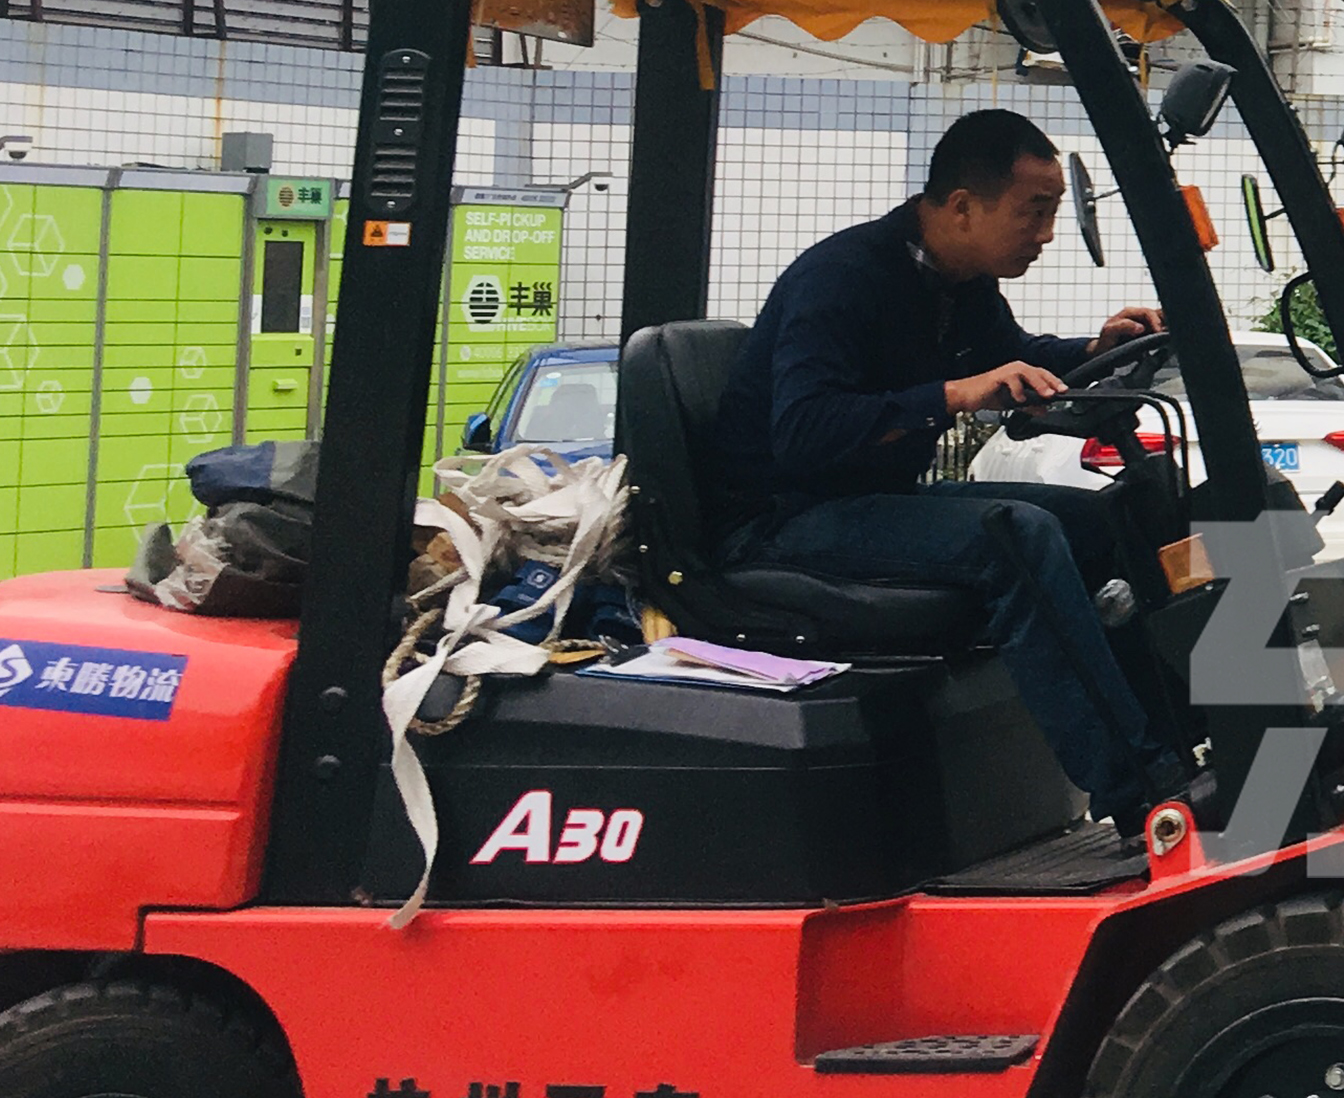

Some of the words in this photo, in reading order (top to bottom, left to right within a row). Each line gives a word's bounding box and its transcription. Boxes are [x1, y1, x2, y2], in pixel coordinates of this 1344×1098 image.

[465, 211, 546, 227] SELF-PICKUP
[464, 229, 492, 243] AND
[493, 229, 555, 244] DROP-OFF
[463, 246, 515, 260] SERVICE
[508, 281, 553, 316] 丰巢
[34, 657, 183, 703] 東勝物流
[468, 788, 645, 865] A30
